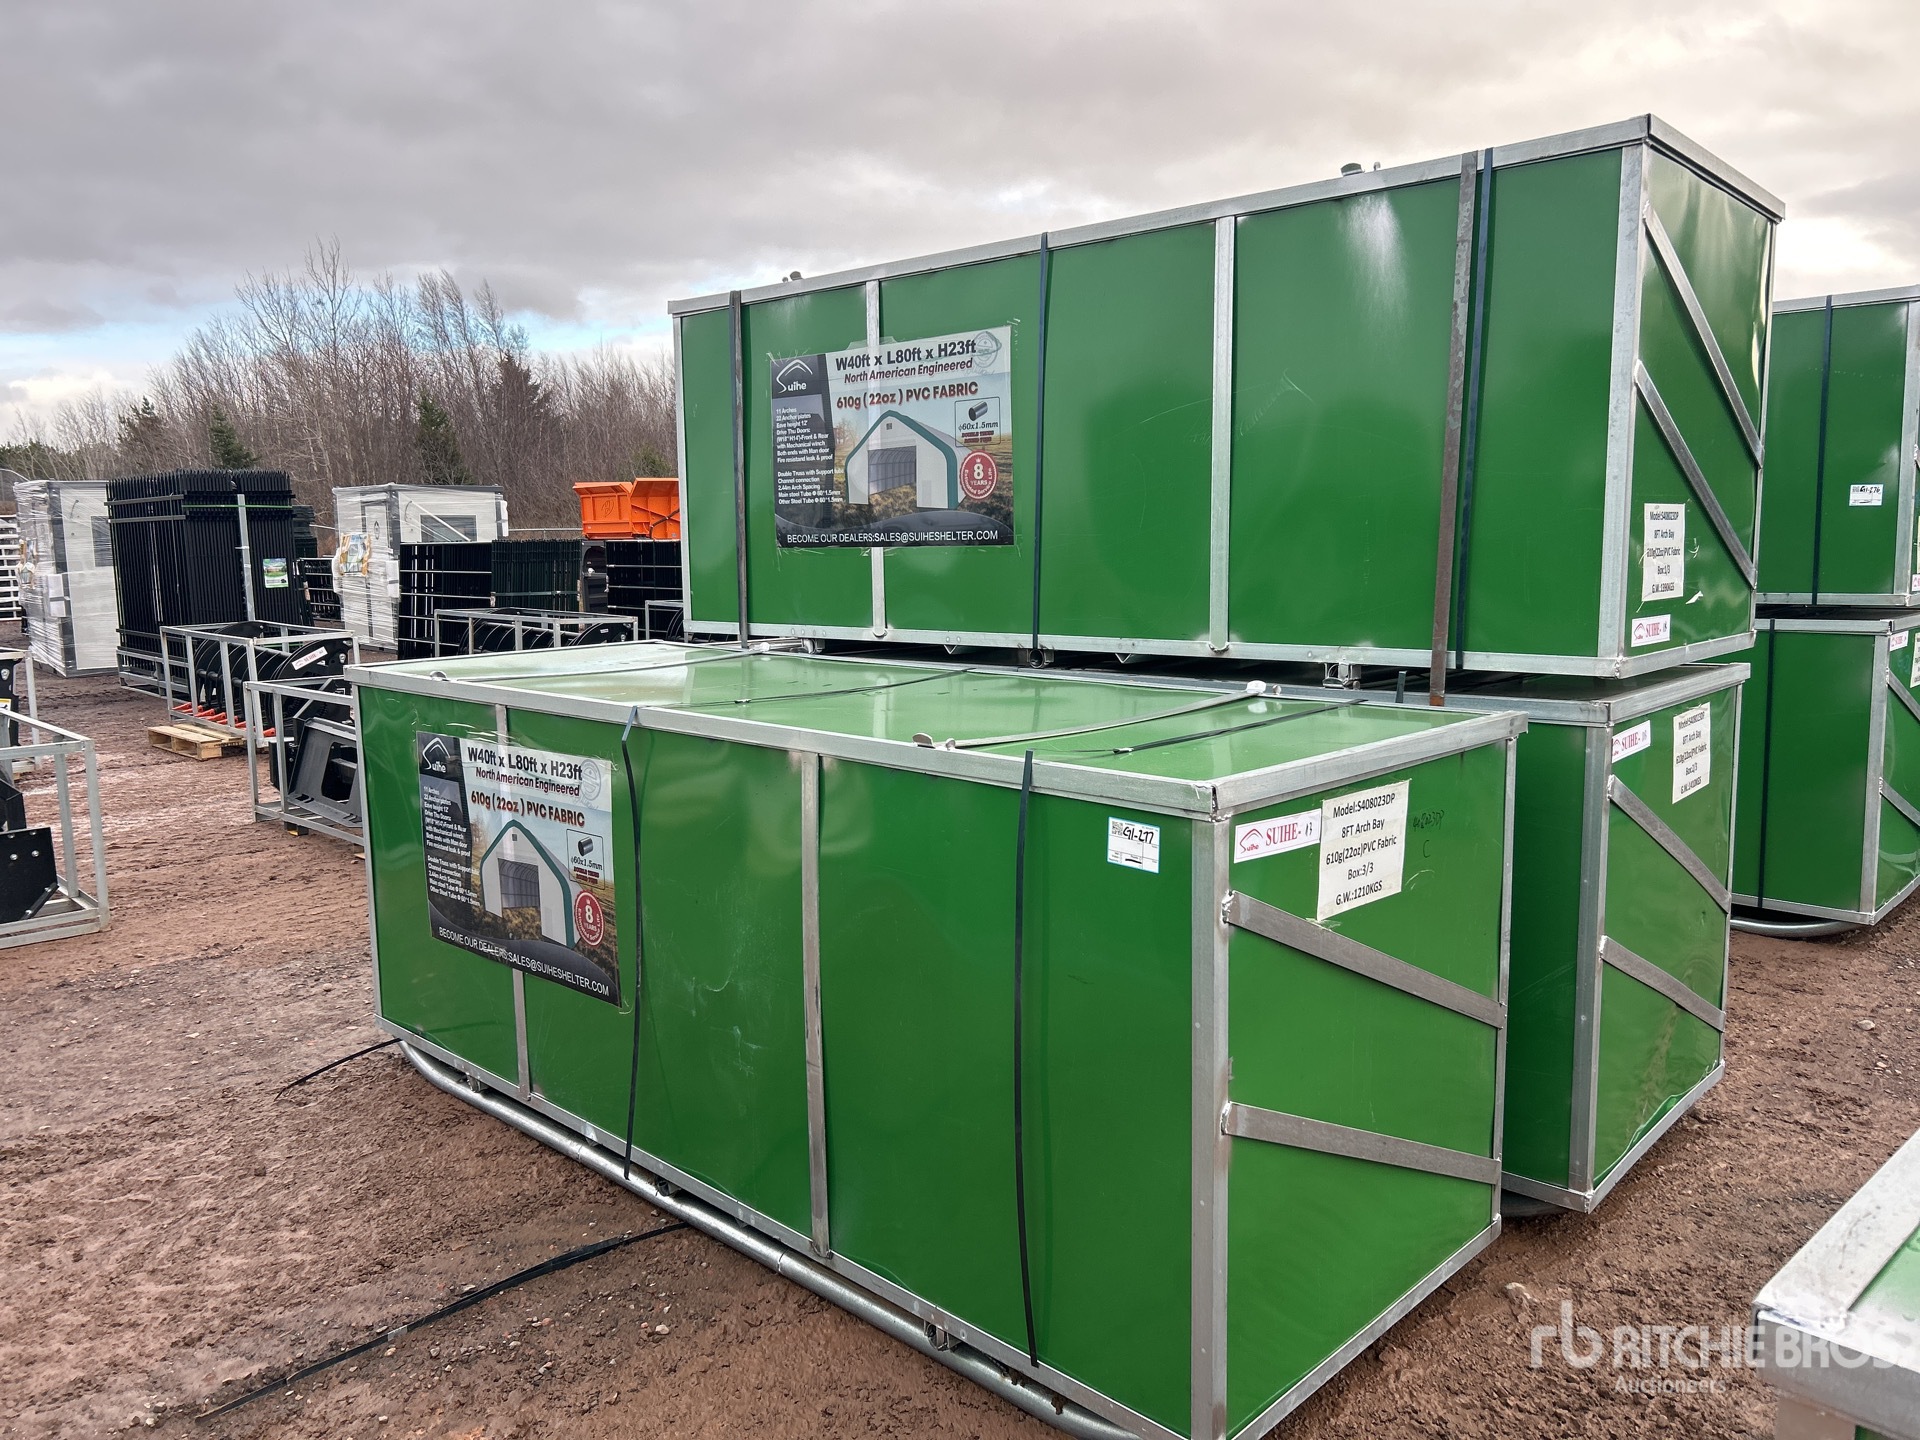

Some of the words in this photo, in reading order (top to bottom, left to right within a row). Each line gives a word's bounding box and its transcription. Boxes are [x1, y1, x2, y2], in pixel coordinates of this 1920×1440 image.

[836, 353, 870, 371] W40ft
[874, 355, 883, 366] x
[887, 346, 922, 365] L80ft
[925, 348, 934, 360] x
[938, 339, 976, 358] H23ft
[844, 370, 868, 384] North
[869, 366, 916, 380] American
[918, 357, 973, 376] Engineered
[836, 396, 862, 410] 610g
[906, 386, 931, 402] PVC
[932, 380, 979, 399] FABRIC
[974, 463, 984, 480] 8
[786, 534, 819, 544] BECOME
[820, 534, 838, 543] OUR
[468, 746, 496, 766] W40ft
[499, 756, 505, 767] x
[508, 754, 538, 773] L80ft
[540, 762, 548, 774] x
[551, 760, 583, 781] H23ft
[476, 767, 495, 780] North
[496, 772, 534, 788] American
[535, 777, 580, 796] Engineered
[471, 790, 491, 810] 610g
[527, 801, 547, 818] PVC
[549, 805, 585, 827] FABRIC
[1332, 793, 1396, 818] Model:S408023DP
[1341, 825, 1354, 838] 8FT
[1355, 820, 1370, 835] Arch
[1372, 818, 1385, 830] Bay
[1377, 835, 1397, 850] Fabric
[1347, 862, 1374, 880] Box:3/3
[1336, 880, 1382, 905] G.W.:1210KGS
[585, 904, 594, 924] 8
[439, 927, 464, 944] BECOME
[464, 936, 478, 949] OUR
